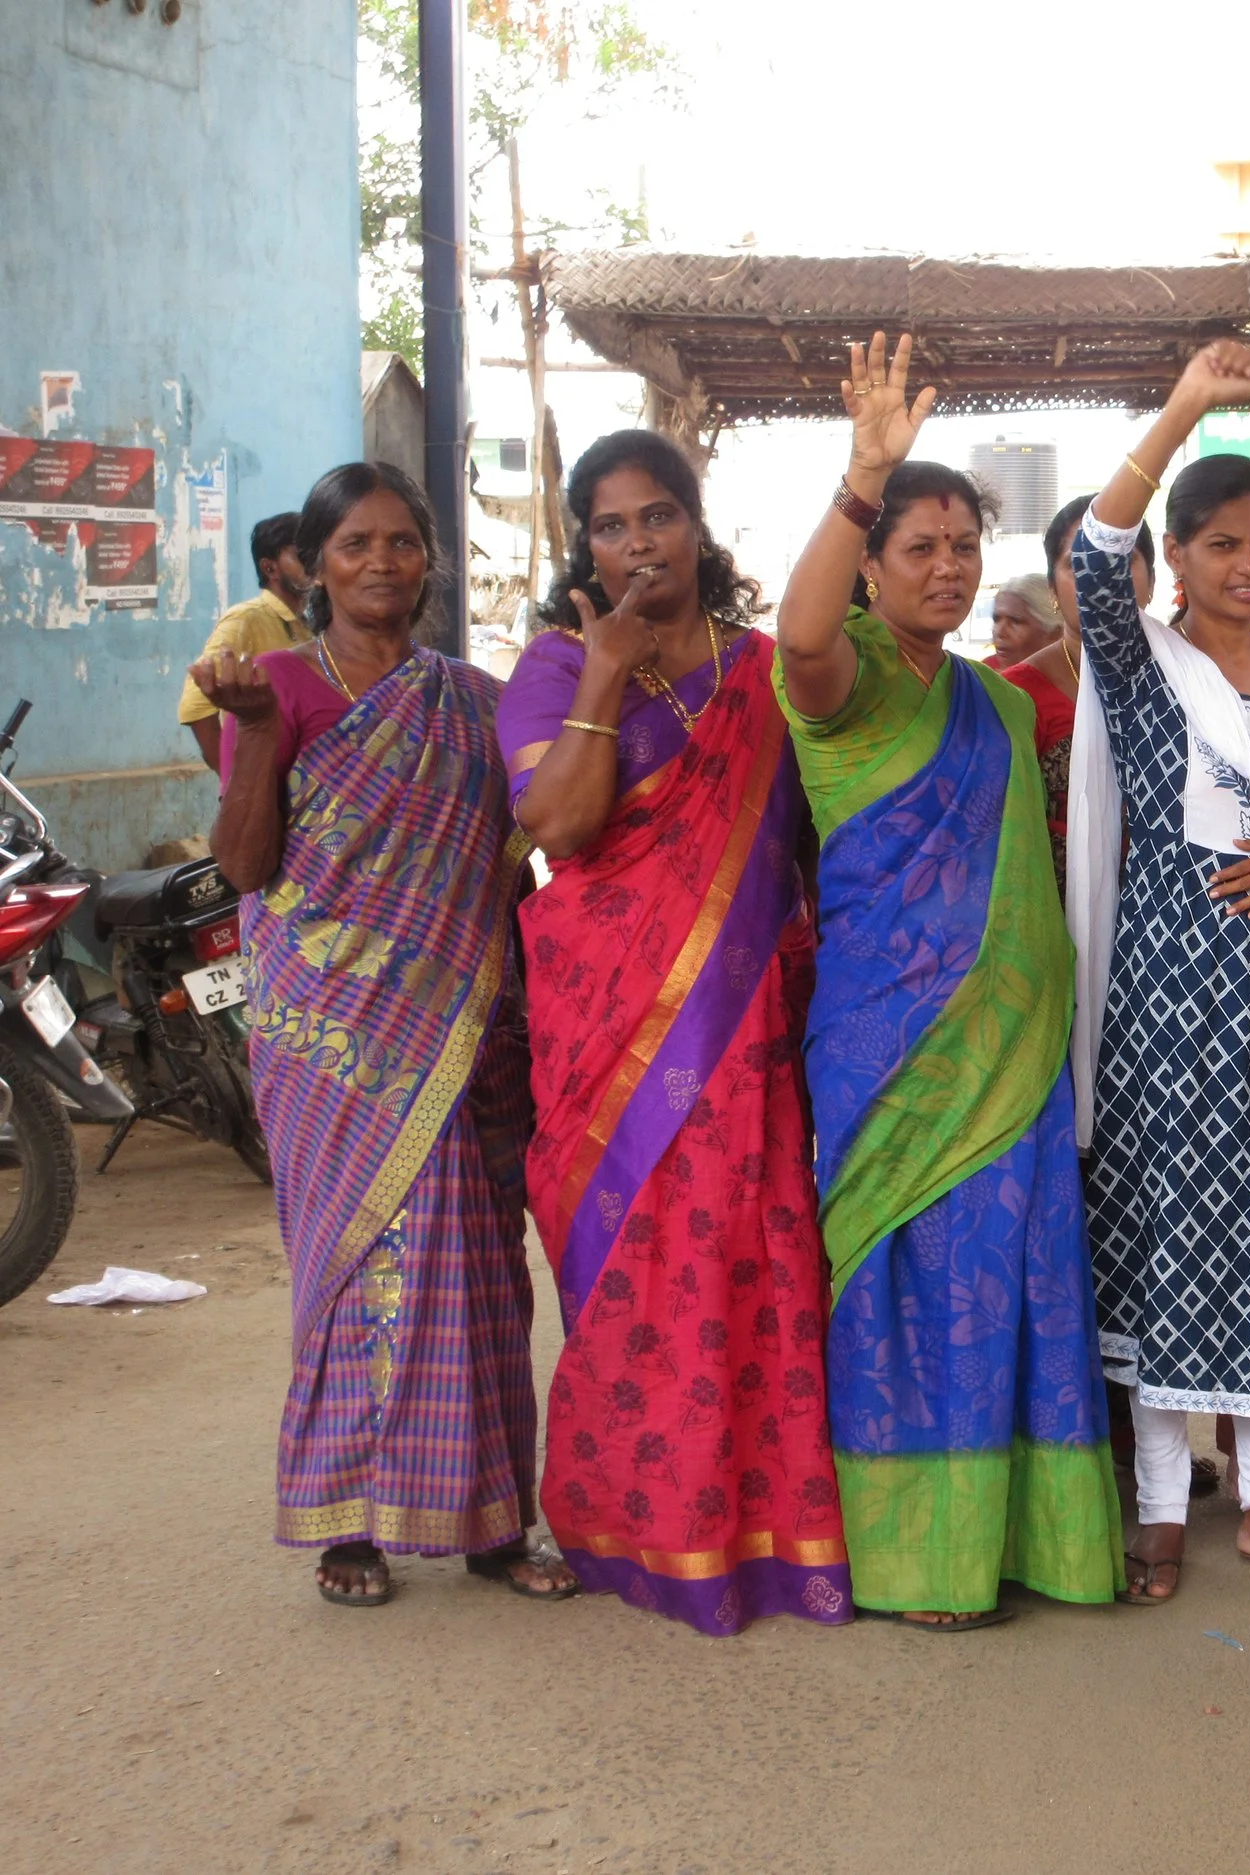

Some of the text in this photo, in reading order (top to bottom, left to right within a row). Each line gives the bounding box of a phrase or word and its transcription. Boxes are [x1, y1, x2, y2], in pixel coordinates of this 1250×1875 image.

[189, 877, 217, 898] TVS
[206, 967, 231, 984] TN
[205, 989, 229, 1006] CZ
